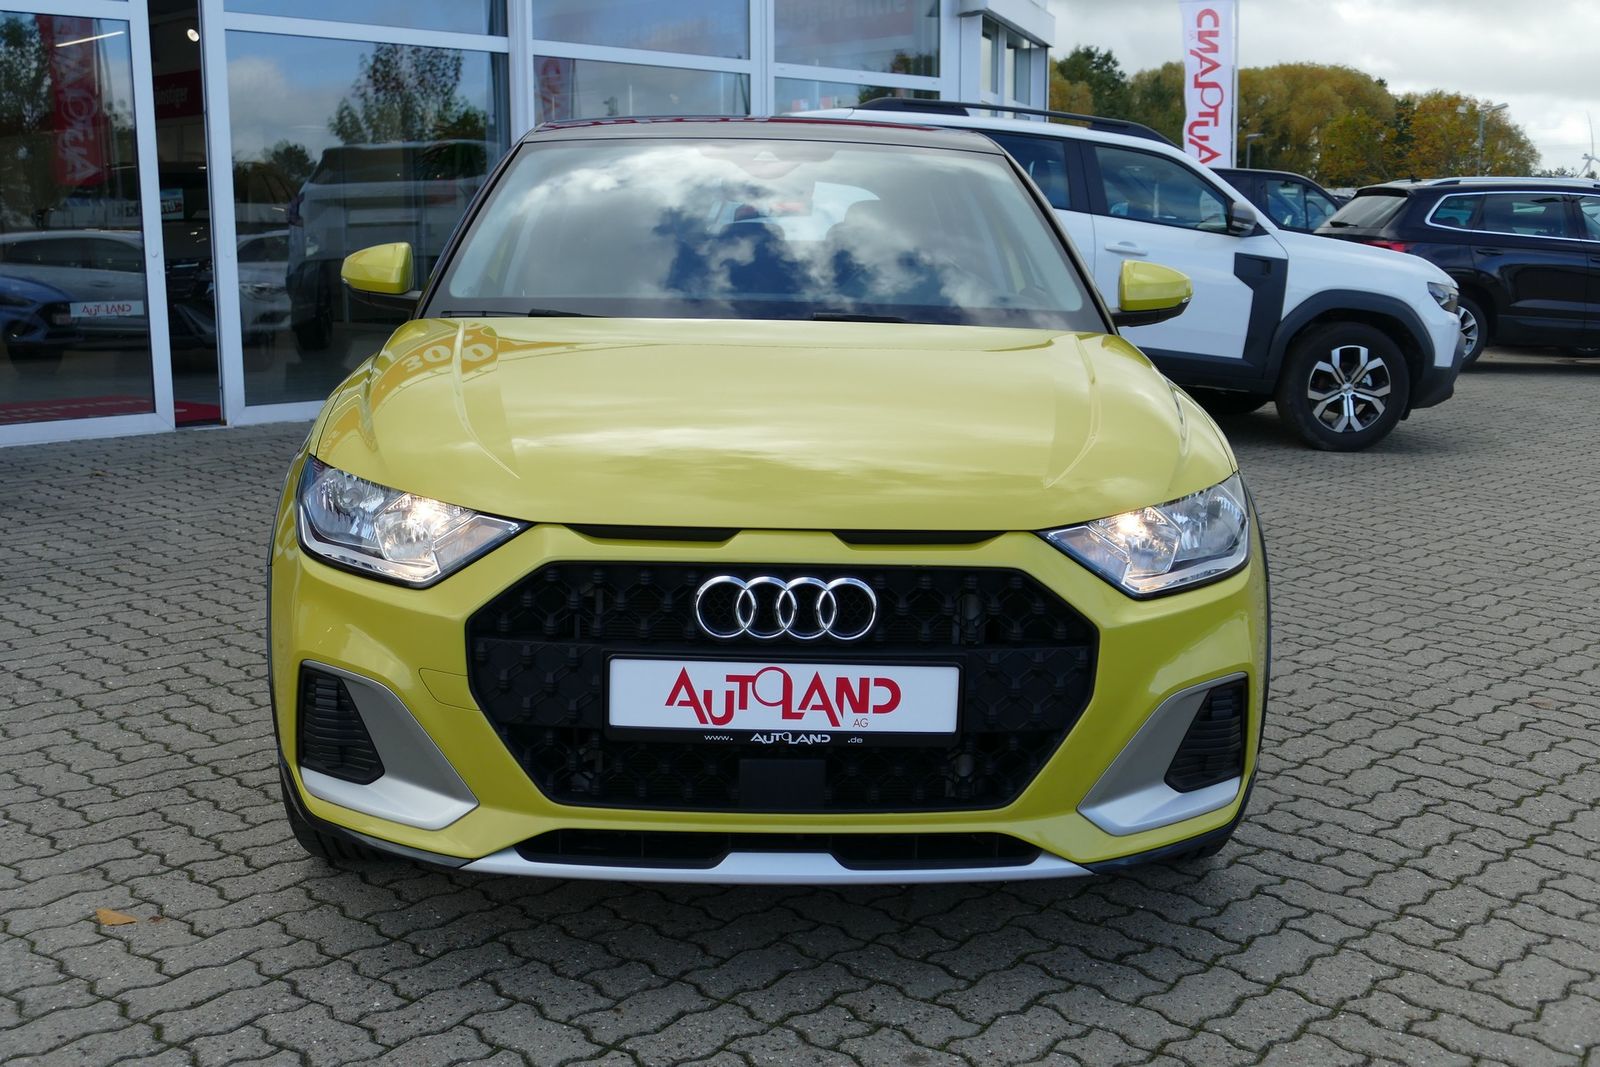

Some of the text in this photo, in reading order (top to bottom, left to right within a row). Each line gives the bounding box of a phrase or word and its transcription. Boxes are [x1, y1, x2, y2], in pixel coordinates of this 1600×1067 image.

[665, 666, 901, 727] AUTOLAND
[853, 718, 869, 728] AG
[750, 732, 832, 745] AUTOLAND
[847, 736, 863, 744] .de
